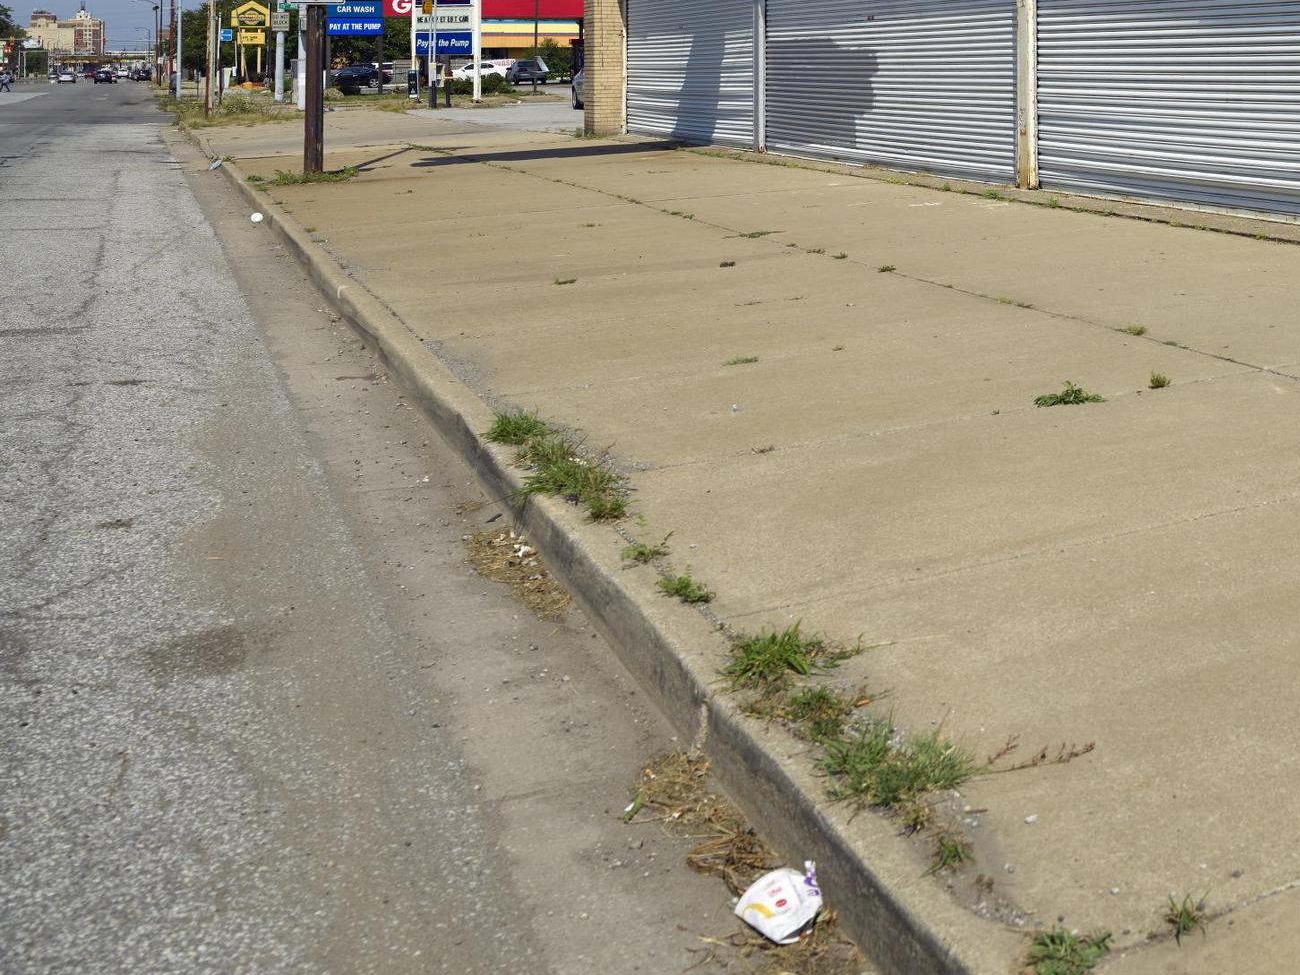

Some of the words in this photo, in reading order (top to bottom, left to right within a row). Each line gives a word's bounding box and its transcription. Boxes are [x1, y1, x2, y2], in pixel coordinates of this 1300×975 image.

[417, 39, 429, 48] Pay
[438, 39, 449, 47] the
[450, 39, 469, 48] Pump
